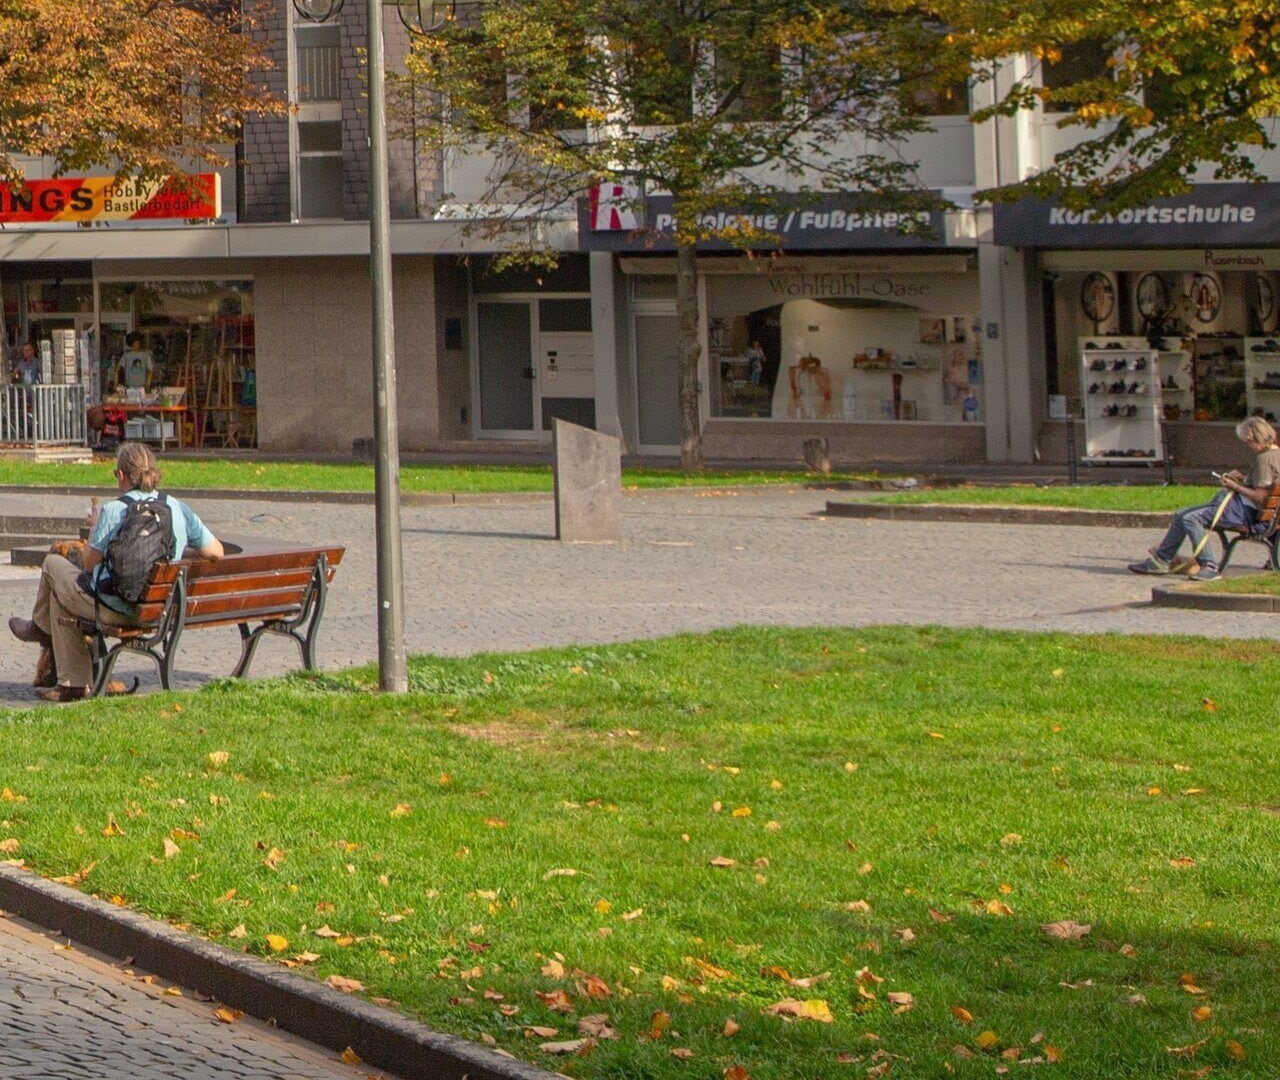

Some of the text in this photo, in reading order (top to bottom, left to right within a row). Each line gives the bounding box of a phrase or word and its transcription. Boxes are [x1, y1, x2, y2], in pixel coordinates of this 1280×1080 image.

[104, 197, 203, 213] Bastlerbedarf
[1048, 204, 1256, 225] Koortschuhe
[769, 272, 932, 297] Wohlfühl-Oase
